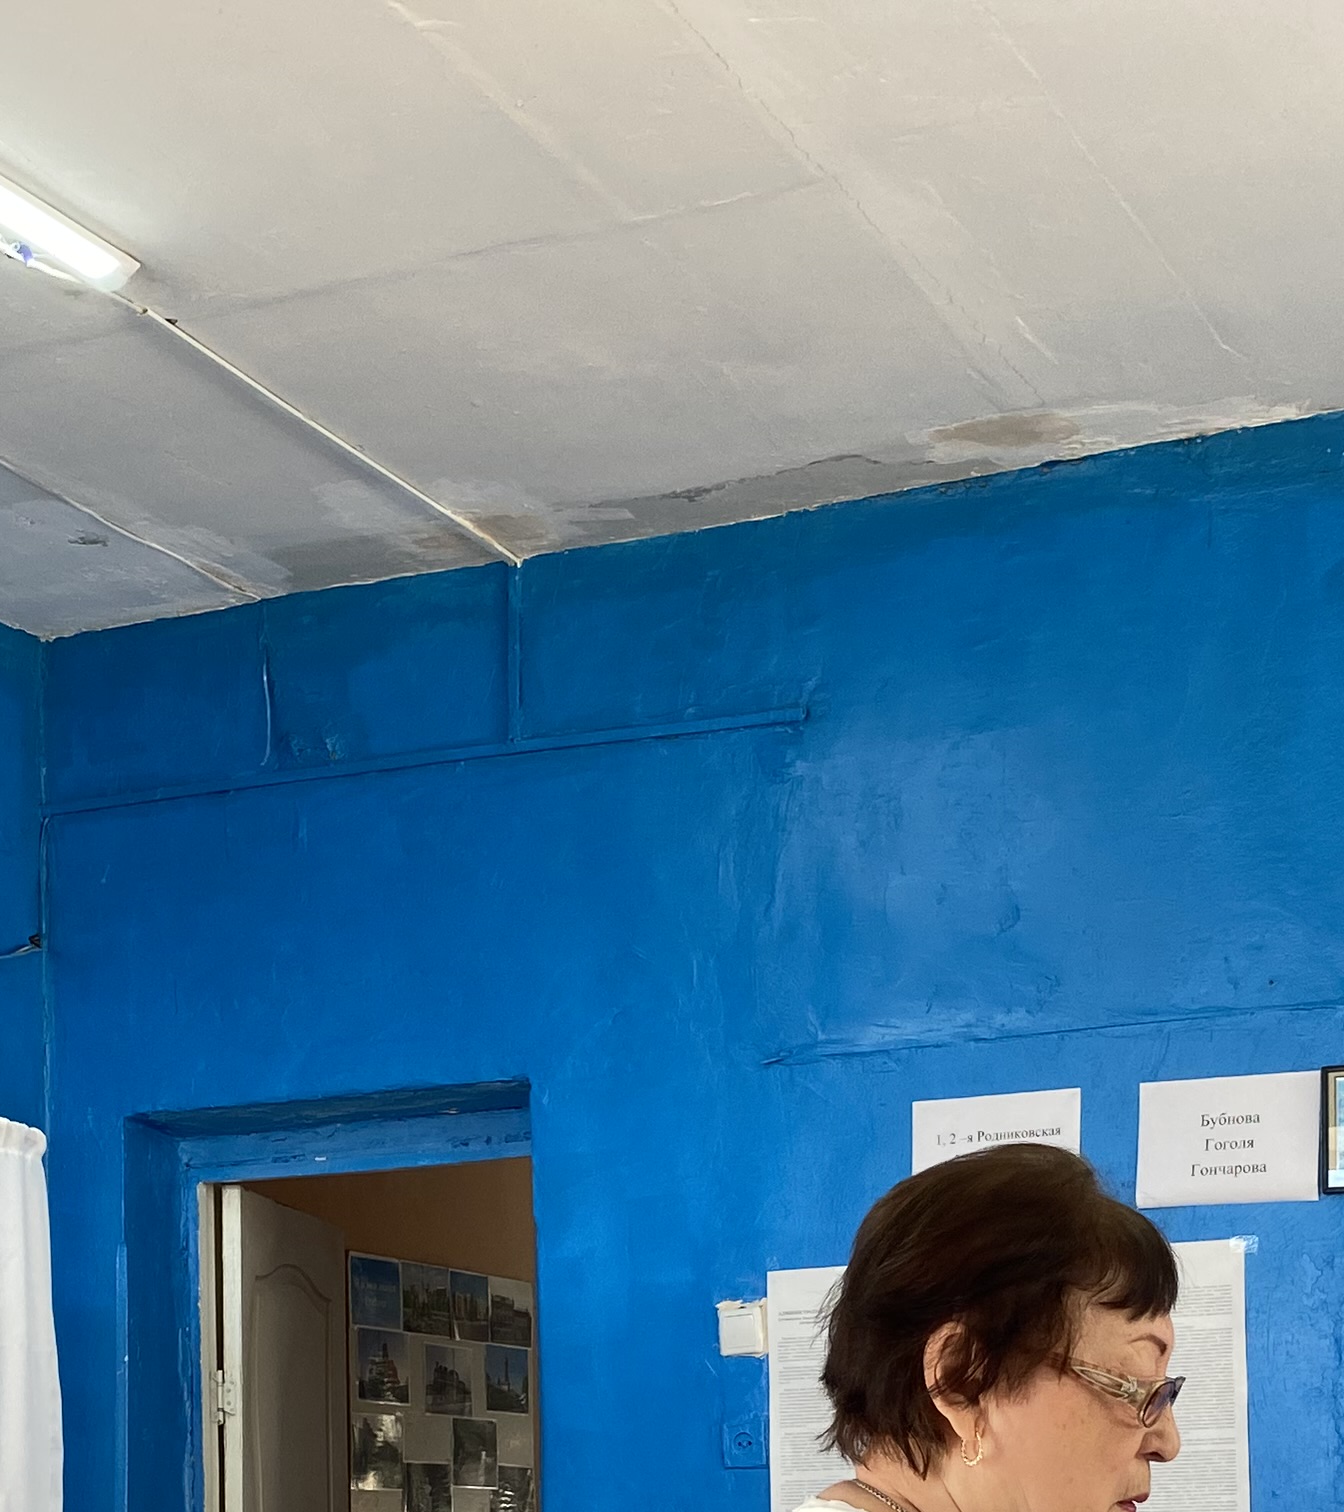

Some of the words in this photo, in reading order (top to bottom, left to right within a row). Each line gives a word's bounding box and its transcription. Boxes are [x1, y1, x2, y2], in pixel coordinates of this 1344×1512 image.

[1200, 1112, 1261, 1130] Бубнова
[977, 1127, 1061, 1142] Родниковская
[1205, 1138, 1254, 1151] Гоголя
[1190, 1163, 1267, 1177] Гончарова
